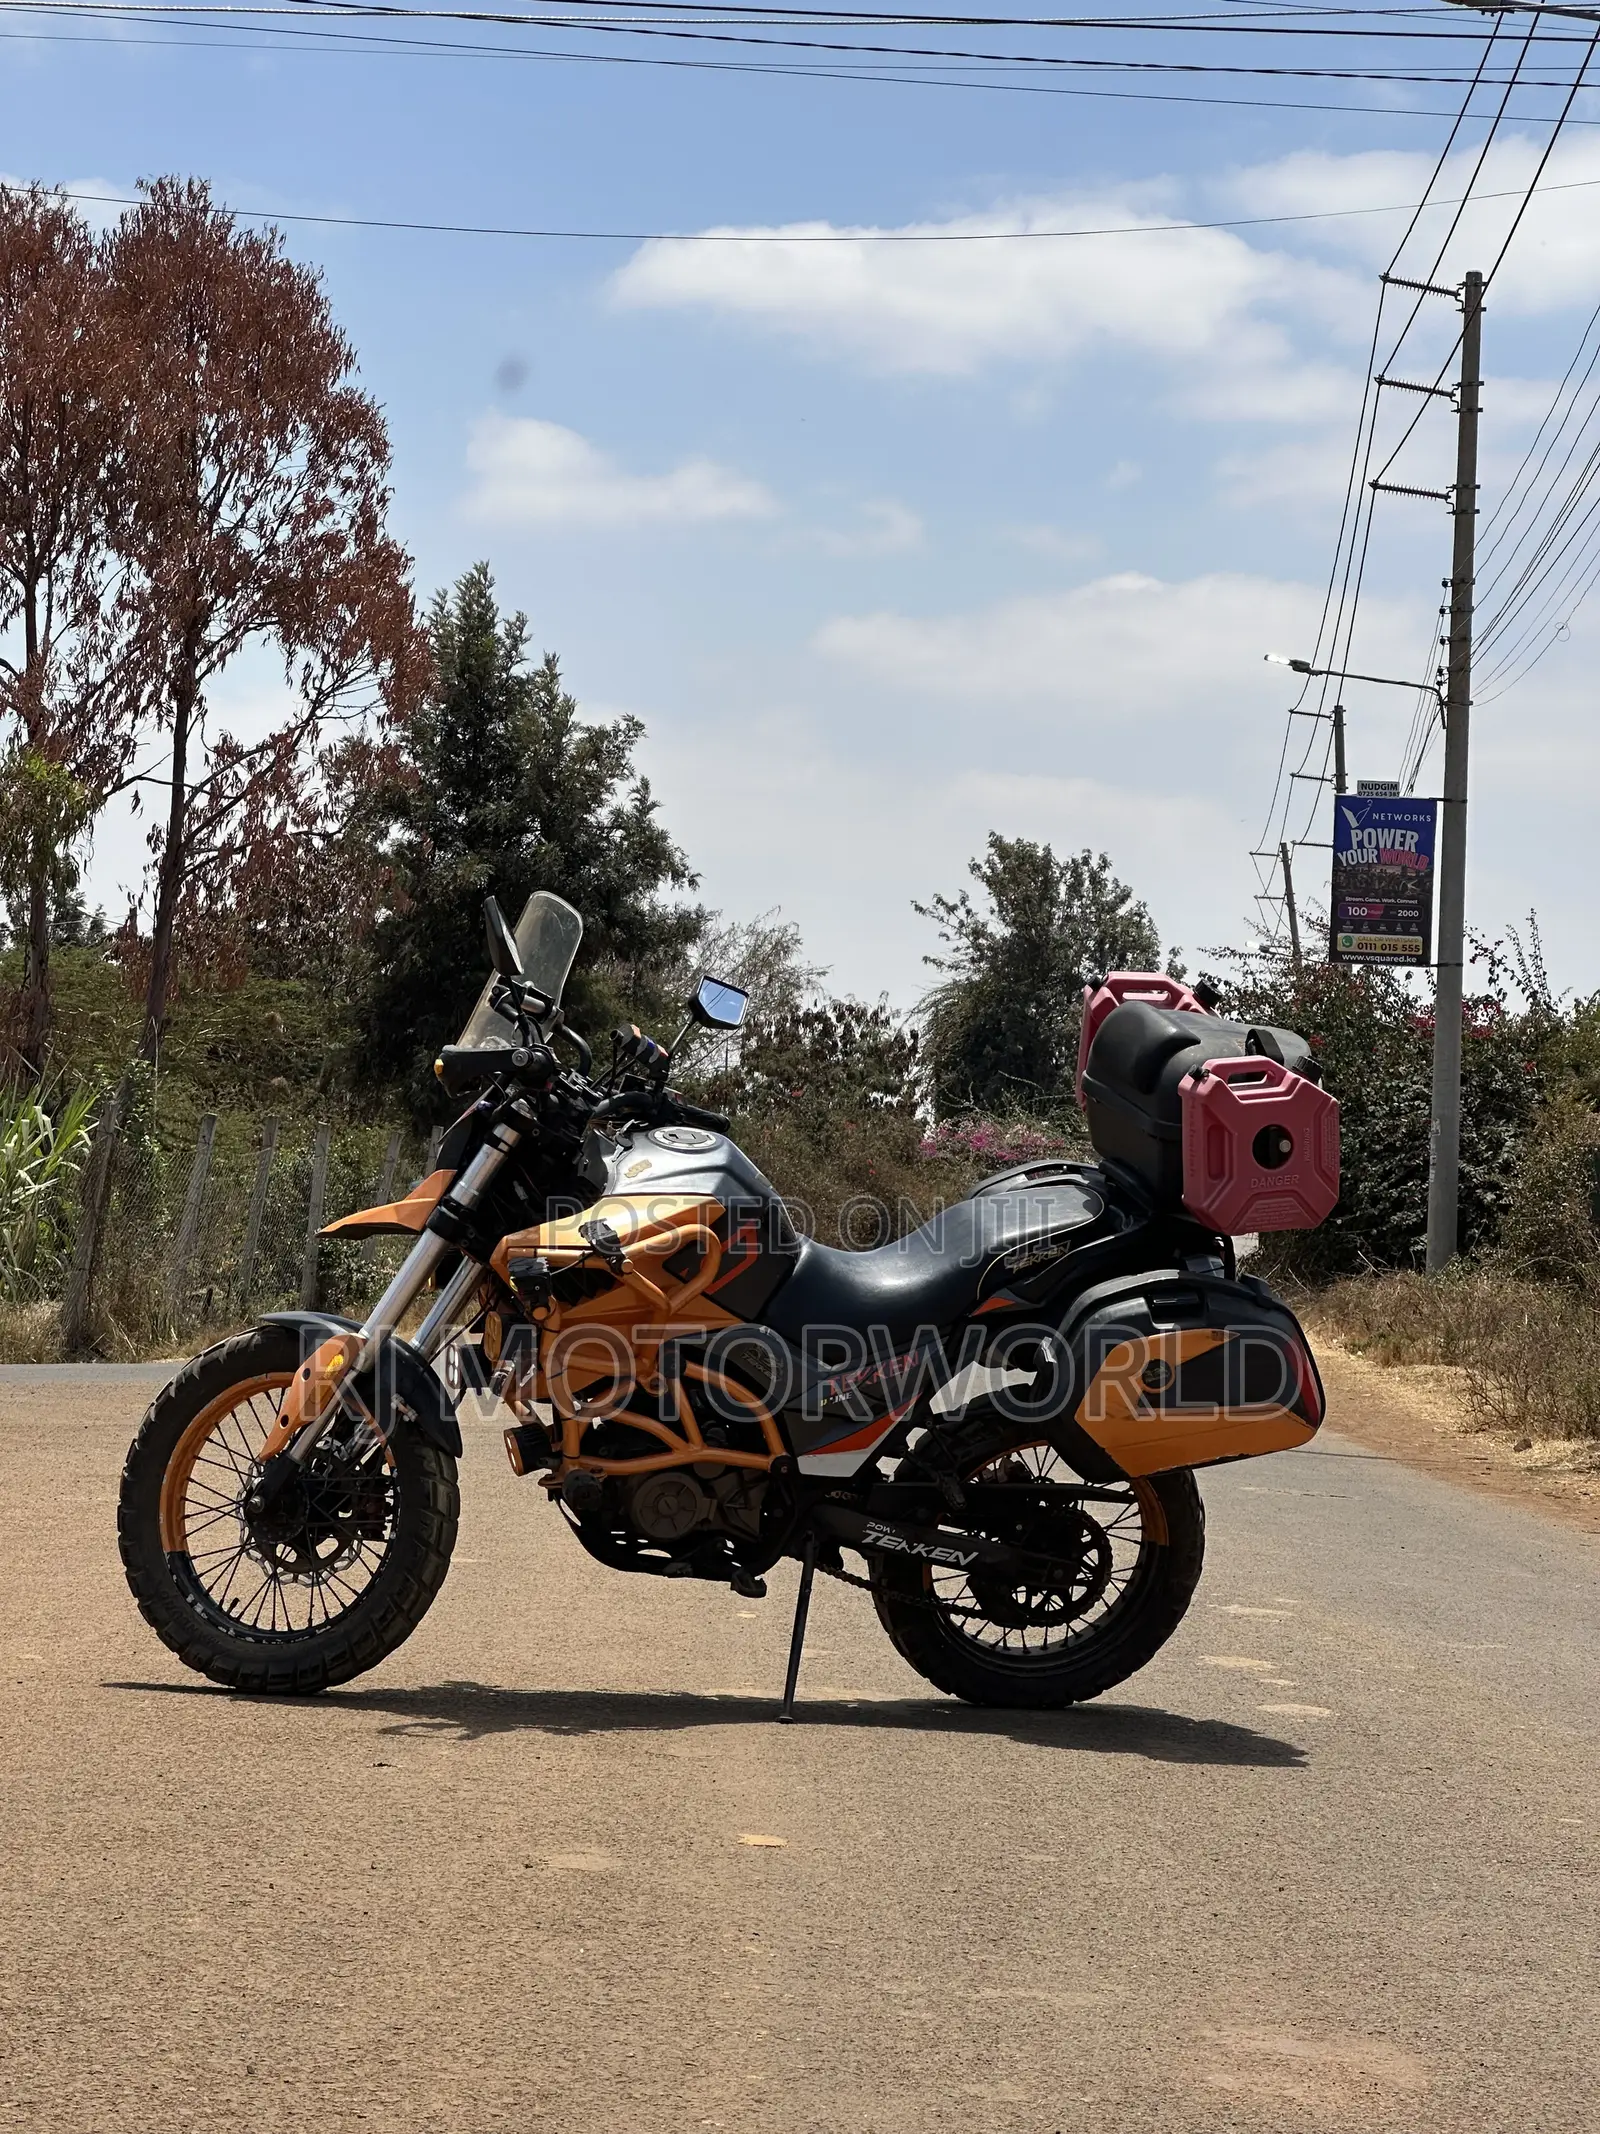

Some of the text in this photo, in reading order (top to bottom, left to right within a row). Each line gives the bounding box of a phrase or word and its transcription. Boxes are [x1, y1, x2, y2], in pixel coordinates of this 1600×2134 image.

[1361, 783, 1398, 791] NUDGIM
[1372, 813, 1432, 822] NETWORKS
[1350, 828, 1419, 853] POWER
[1337, 848, 1430, 870] YOUR WORLD
[1347, 906, 1368, 916] 100
[1397, 909, 1419, 917] 2000
[1357, 942, 1420, 952] 0111 015 555
[1342, 954, 1417, 963] www.vsquared.ke
[1250, 1174, 1300, 1189] DANGER
[861, 1529, 979, 1566] TEKKEN
